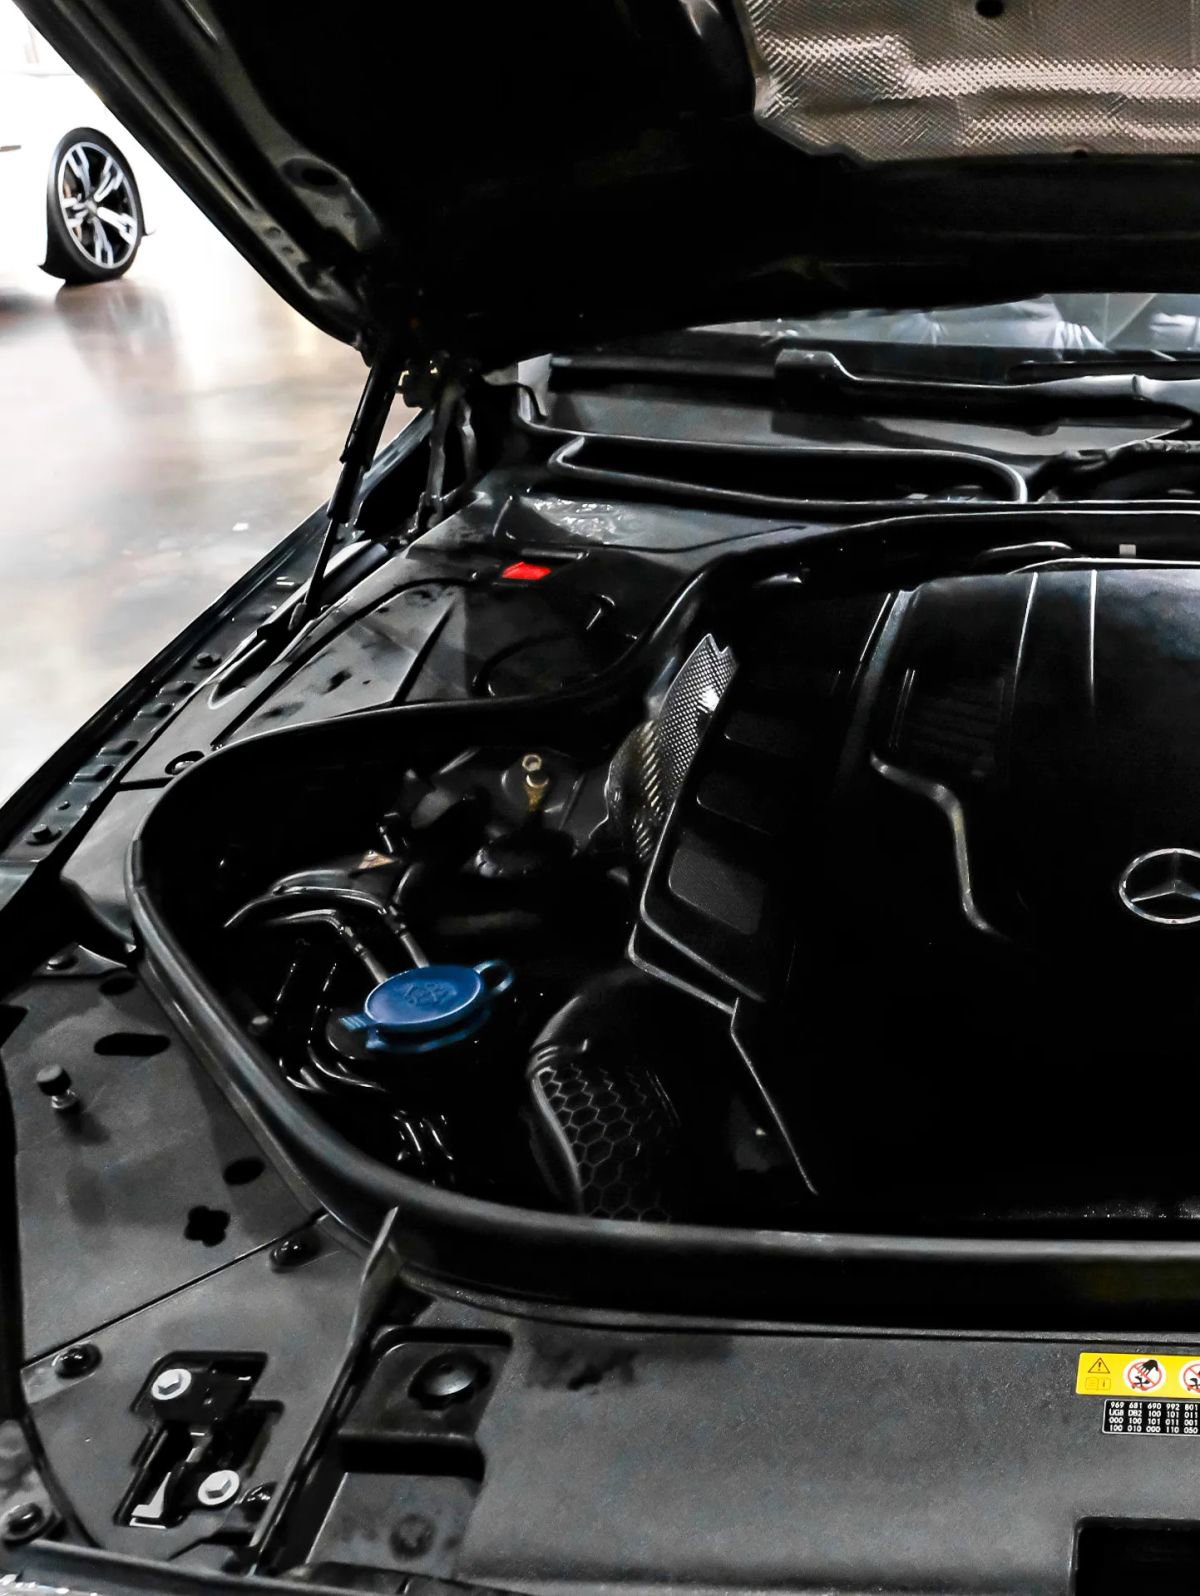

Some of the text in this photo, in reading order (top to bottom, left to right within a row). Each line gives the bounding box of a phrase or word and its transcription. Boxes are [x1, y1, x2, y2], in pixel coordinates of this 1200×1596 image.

[1110, 1401, 1125, 1409] 969
[1128, 1401, 1143, 1409] 681
[1147, 1402, 1162, 1410] 690
[1166, 1403, 1180, 1411] 992
[1148, 1410, 1162, 1418] 100
[1184, 1411, 1198, 1419] 011
[1108, 1416, 1124, 1424] 000
[1128, 1417, 1143, 1425] 100
[1165, 1418, 1179, 1426] 011
[1109, 1424, 1123, 1432] 100
[1127, 1424, 1142, 1432] 010
[1145, 1425, 1161, 1433] 000
[1166, 1426, 1180, 1434] 110
